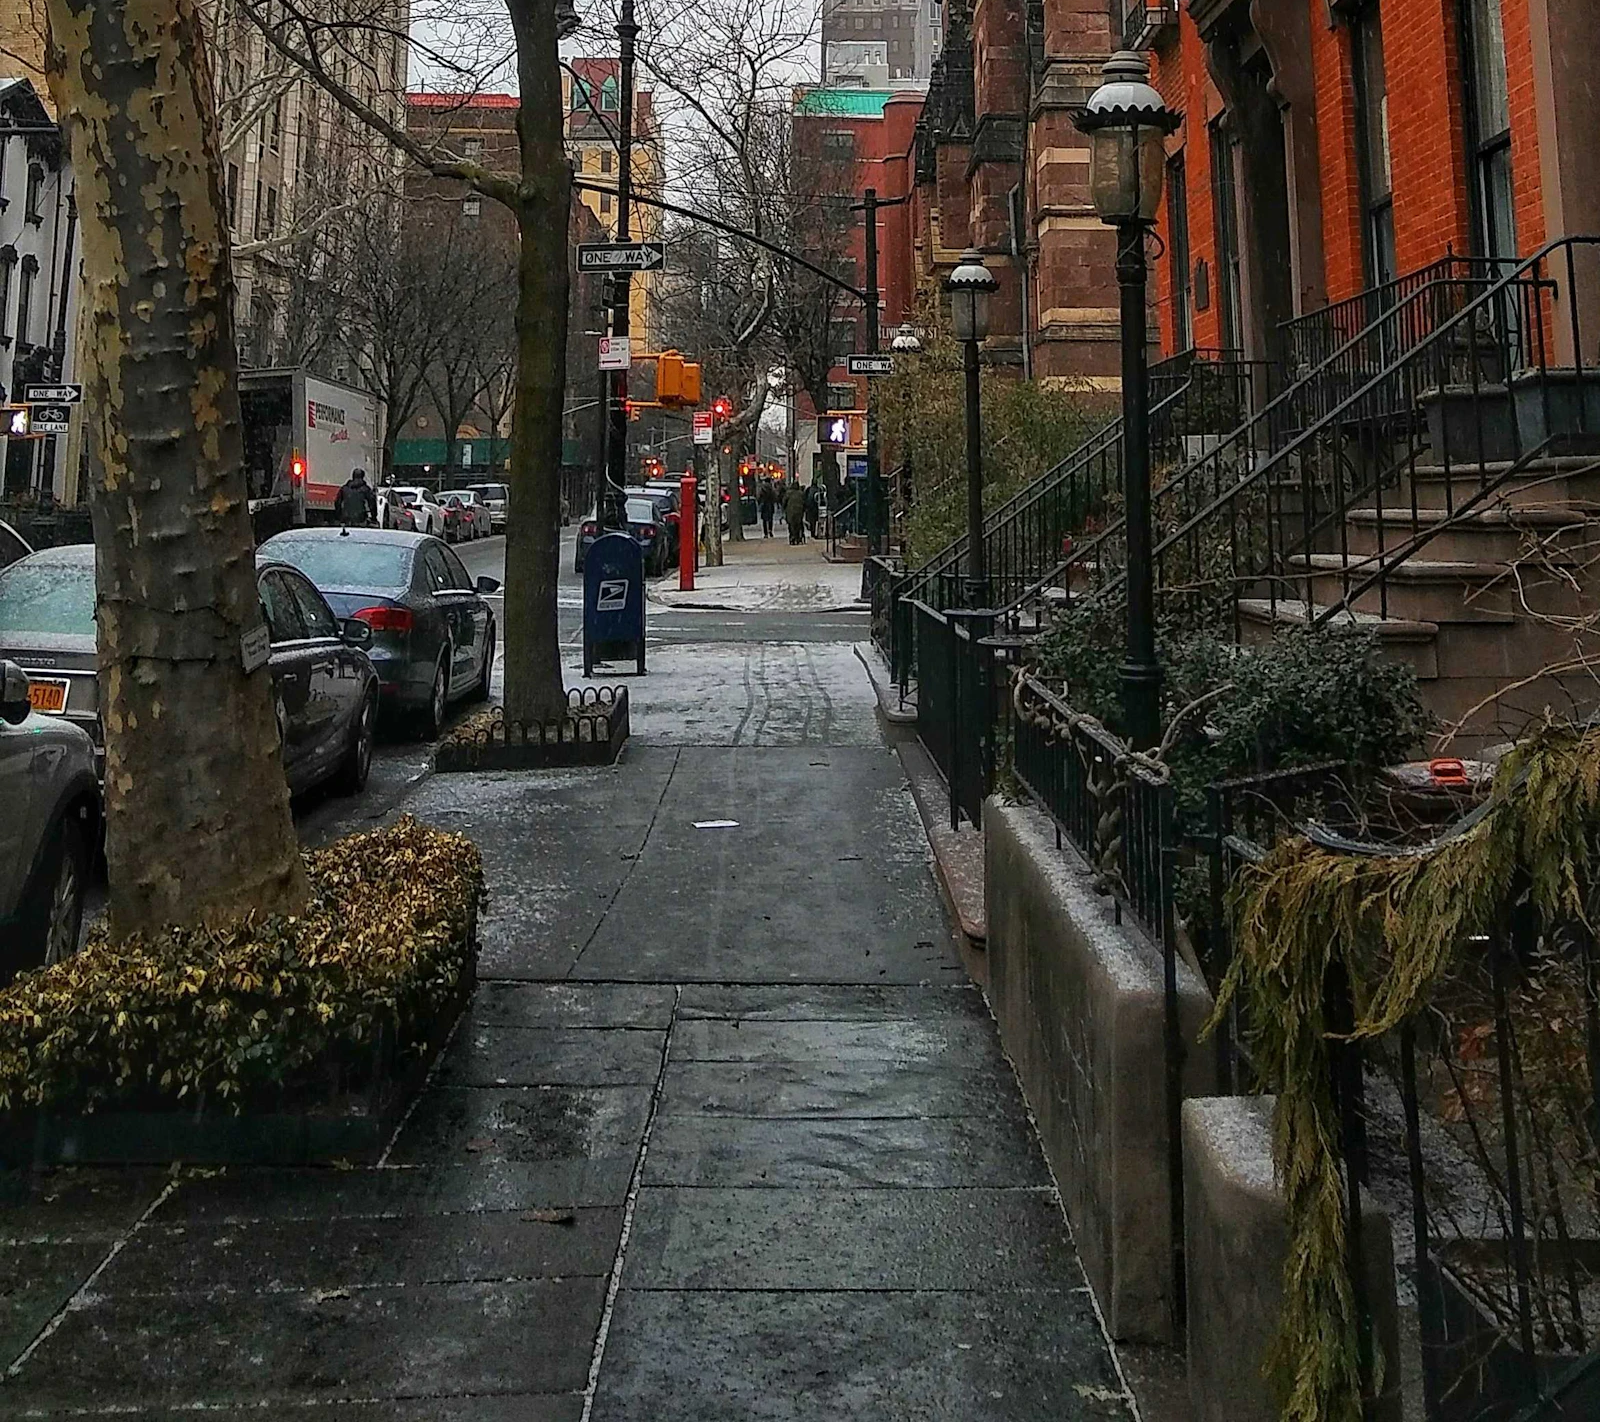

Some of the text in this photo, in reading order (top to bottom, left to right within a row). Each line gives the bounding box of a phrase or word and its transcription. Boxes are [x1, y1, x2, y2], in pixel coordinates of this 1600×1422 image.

[585, 250, 653, 263] ONE WAY
[928, 327, 937, 339] ST
[856, 361, 873, 370] ONE
[881, 361, 895, 370] WA
[33, 390, 73, 398] ONE WAY
[33, 423, 67, 431] BIKE LANE
